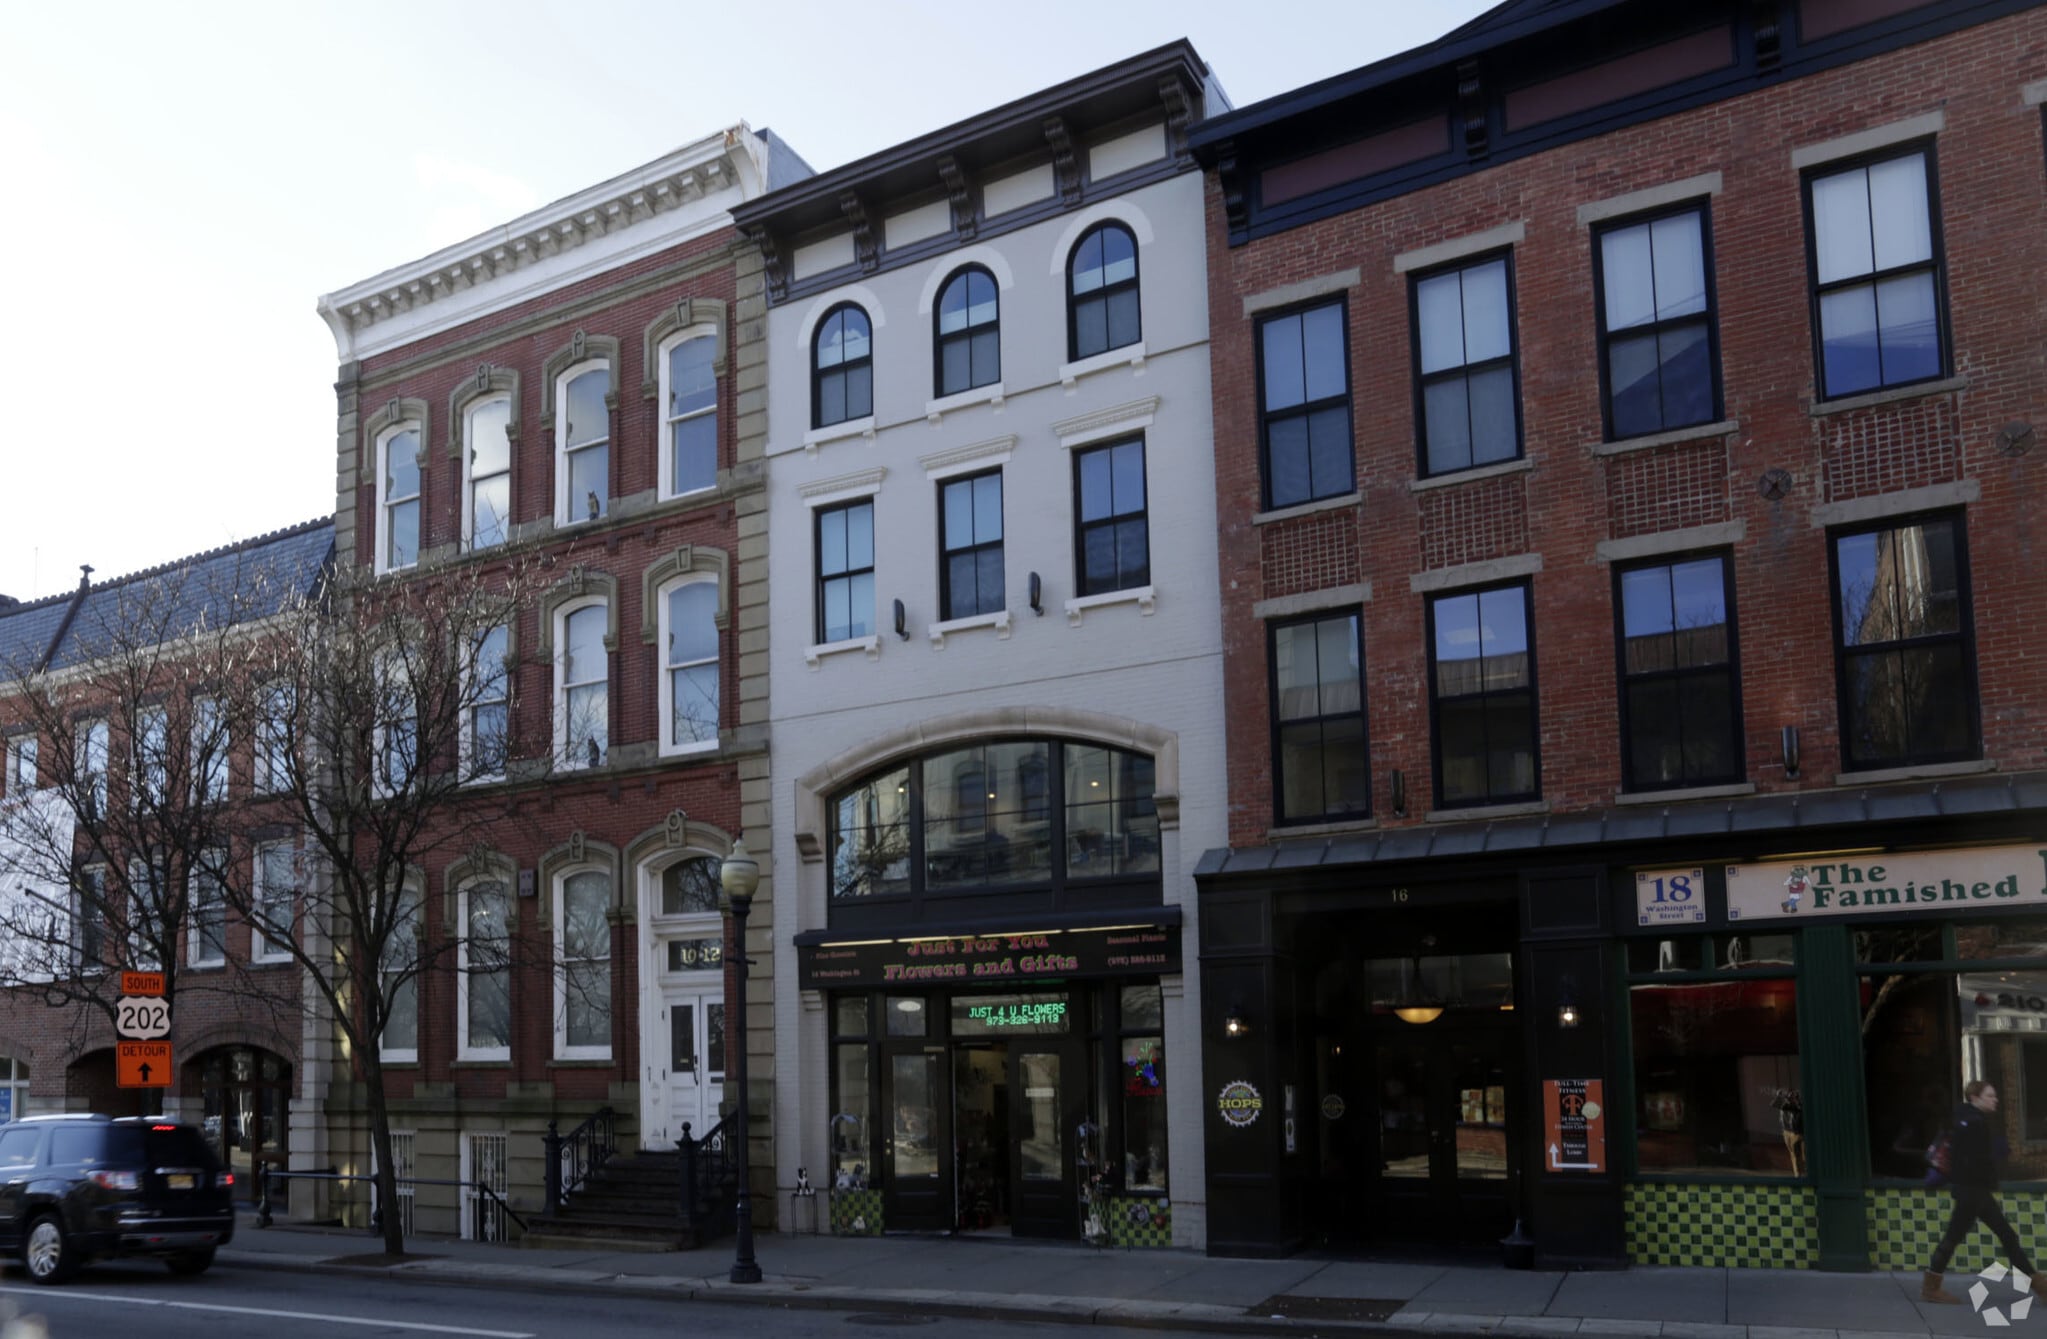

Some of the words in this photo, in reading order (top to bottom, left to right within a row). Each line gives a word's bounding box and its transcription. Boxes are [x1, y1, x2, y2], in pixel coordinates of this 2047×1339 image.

[1811, 863, 1887, 885] The
[1392, 887, 1409, 903] 16
[1650, 876, 1692, 903] 18
[1812, 875, 2020, 908] Famished
[1646, 904, 1698, 912] Washington
[907, 940, 956, 957] Just
[961, 937, 1000, 954] For
[1007, 934, 1050, 951] You
[883, 962, 968, 980] Flowers
[973, 957, 1016, 976] and
[1019, 954, 1079, 973] Gifts
[127, 977, 160, 990] SOUTH
[123, 1006, 165, 1030] 202
[968, 1006, 993, 1018] JUST
[998, 1005, 1005, 1017] 4
[1009, 1004, 1017, 1016] U
[1021, 1002, 1066, 1016] FLOWERS
[123, 1046, 166, 1057] DETOUR
[1218, 1098, 1263, 1109] HOPS
